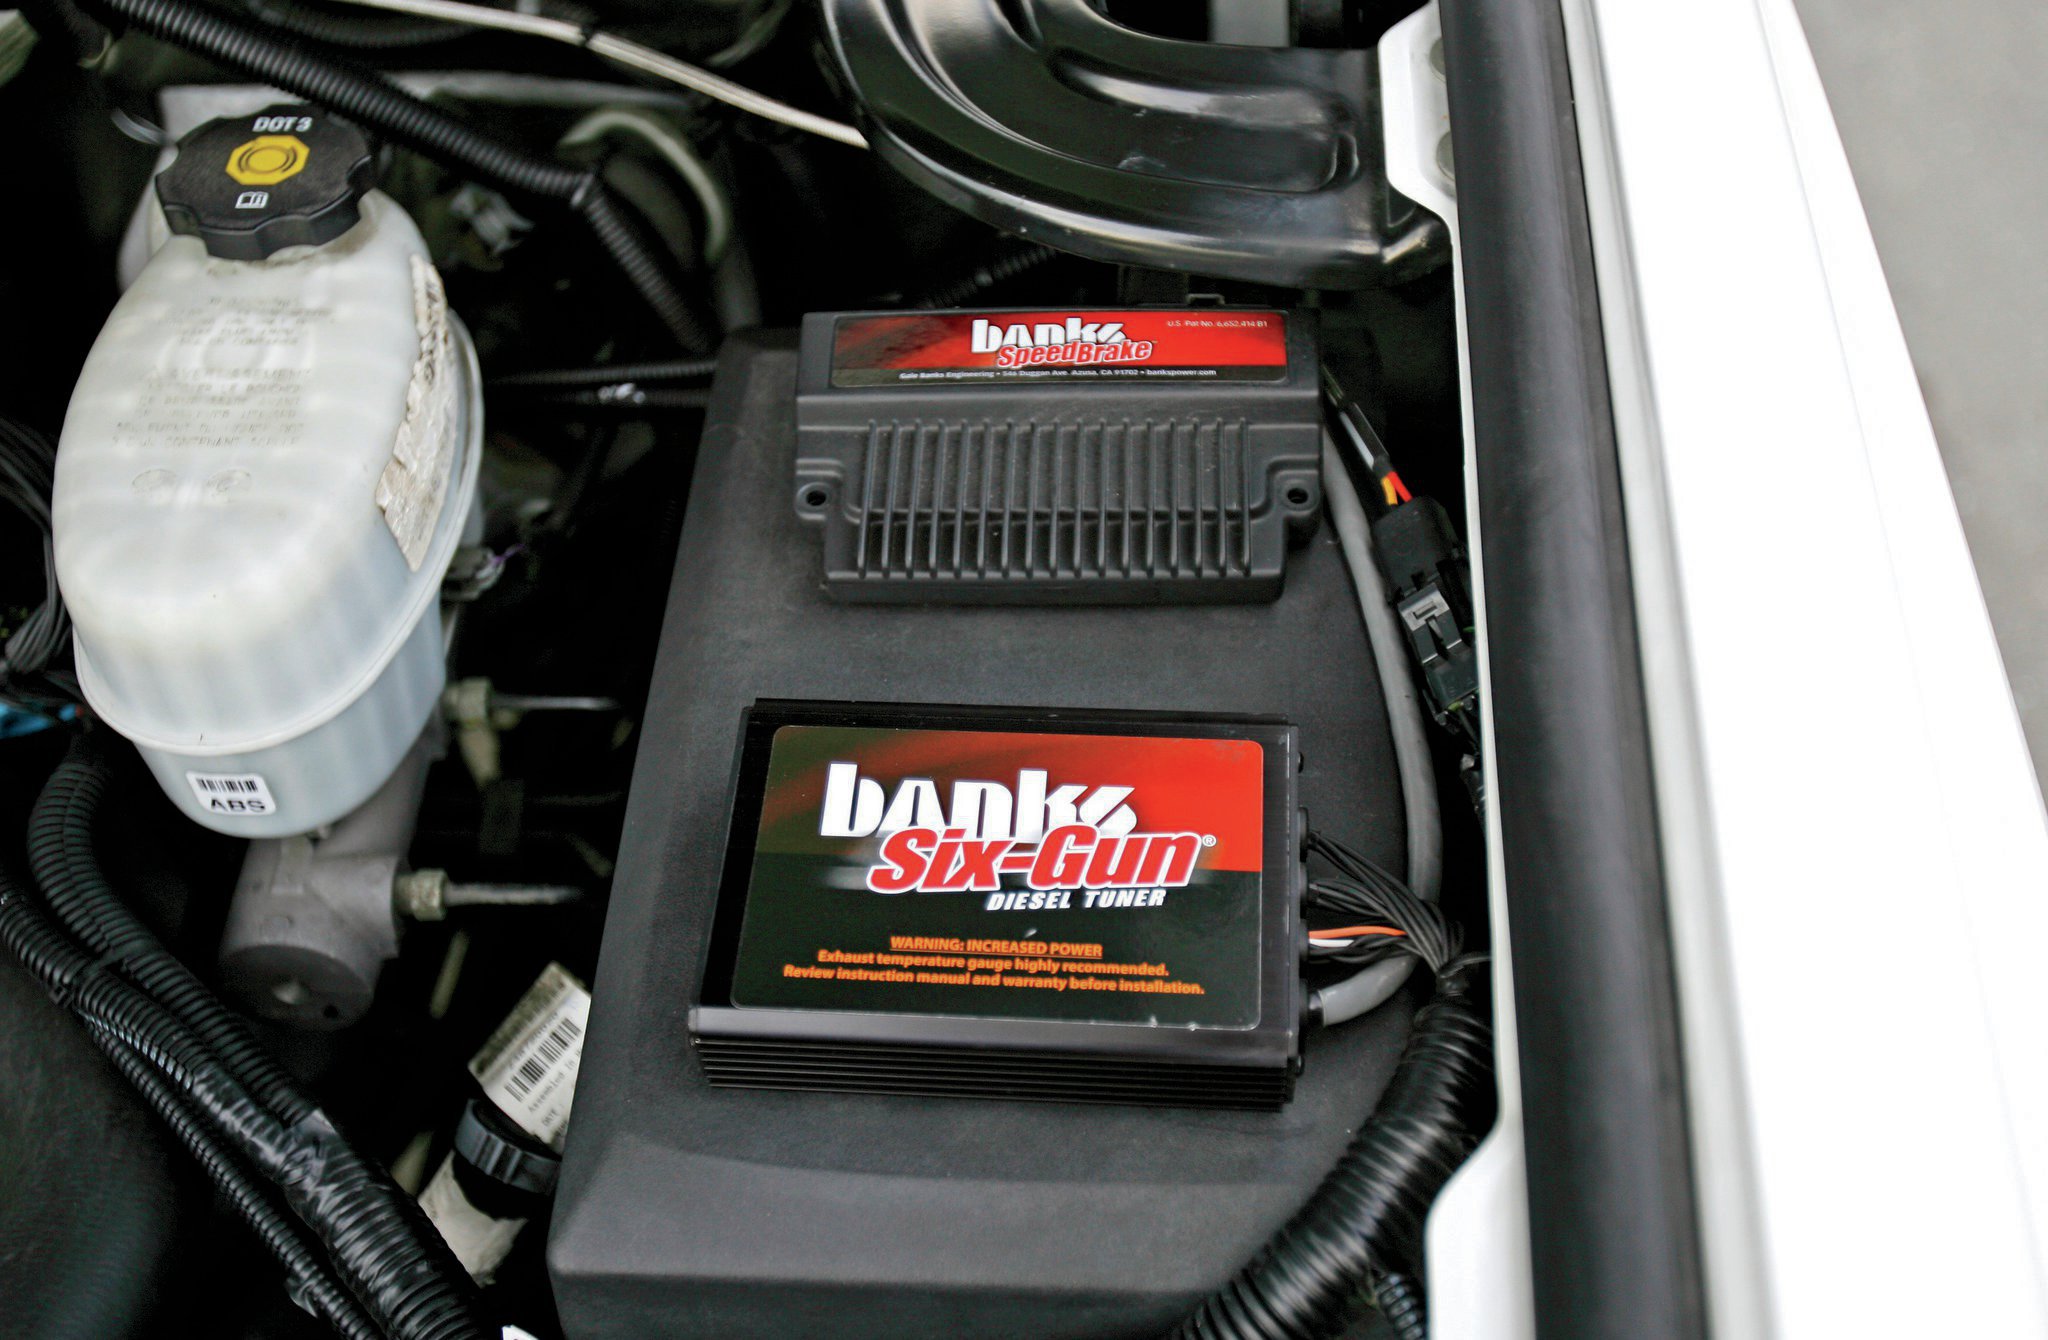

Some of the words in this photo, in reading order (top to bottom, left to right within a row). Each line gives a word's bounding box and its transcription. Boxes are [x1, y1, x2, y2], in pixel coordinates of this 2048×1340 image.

[252, 116, 298, 132] DOT
[296, 116, 313, 132] 3
[997, 339, 1153, 368] SpeedBrake
[946, 371, 995, 379] Engineering
[1146, 369, 1217, 377] bankspower.com
[210, 799, 266, 813] ABS
[985, 890, 1072, 911] DIESEL
[1084, 888, 1167, 909] TUNER
[890, 936, 964, 952] WARNING:
[966, 938, 1049, 955] INCREASED
[1050, 942, 1103, 958] POWER
[817, 949, 875, 964] Exhaust
[876, 952, 966, 968] temperature
[967, 957, 1013, 972] gauge
[1014, 958, 1060, 974] highly
[1062, 961, 1170, 977] recommended.
[783, 964, 835, 979] Review
[836, 967, 915, 983] instruction
[916, 971, 970, 985] manual
[972, 973, 1001, 987] and
[1003, 976, 1067, 992] warranty
[1068, 976, 1117, 991] before
[1118, 978, 1206, 995] installation.
